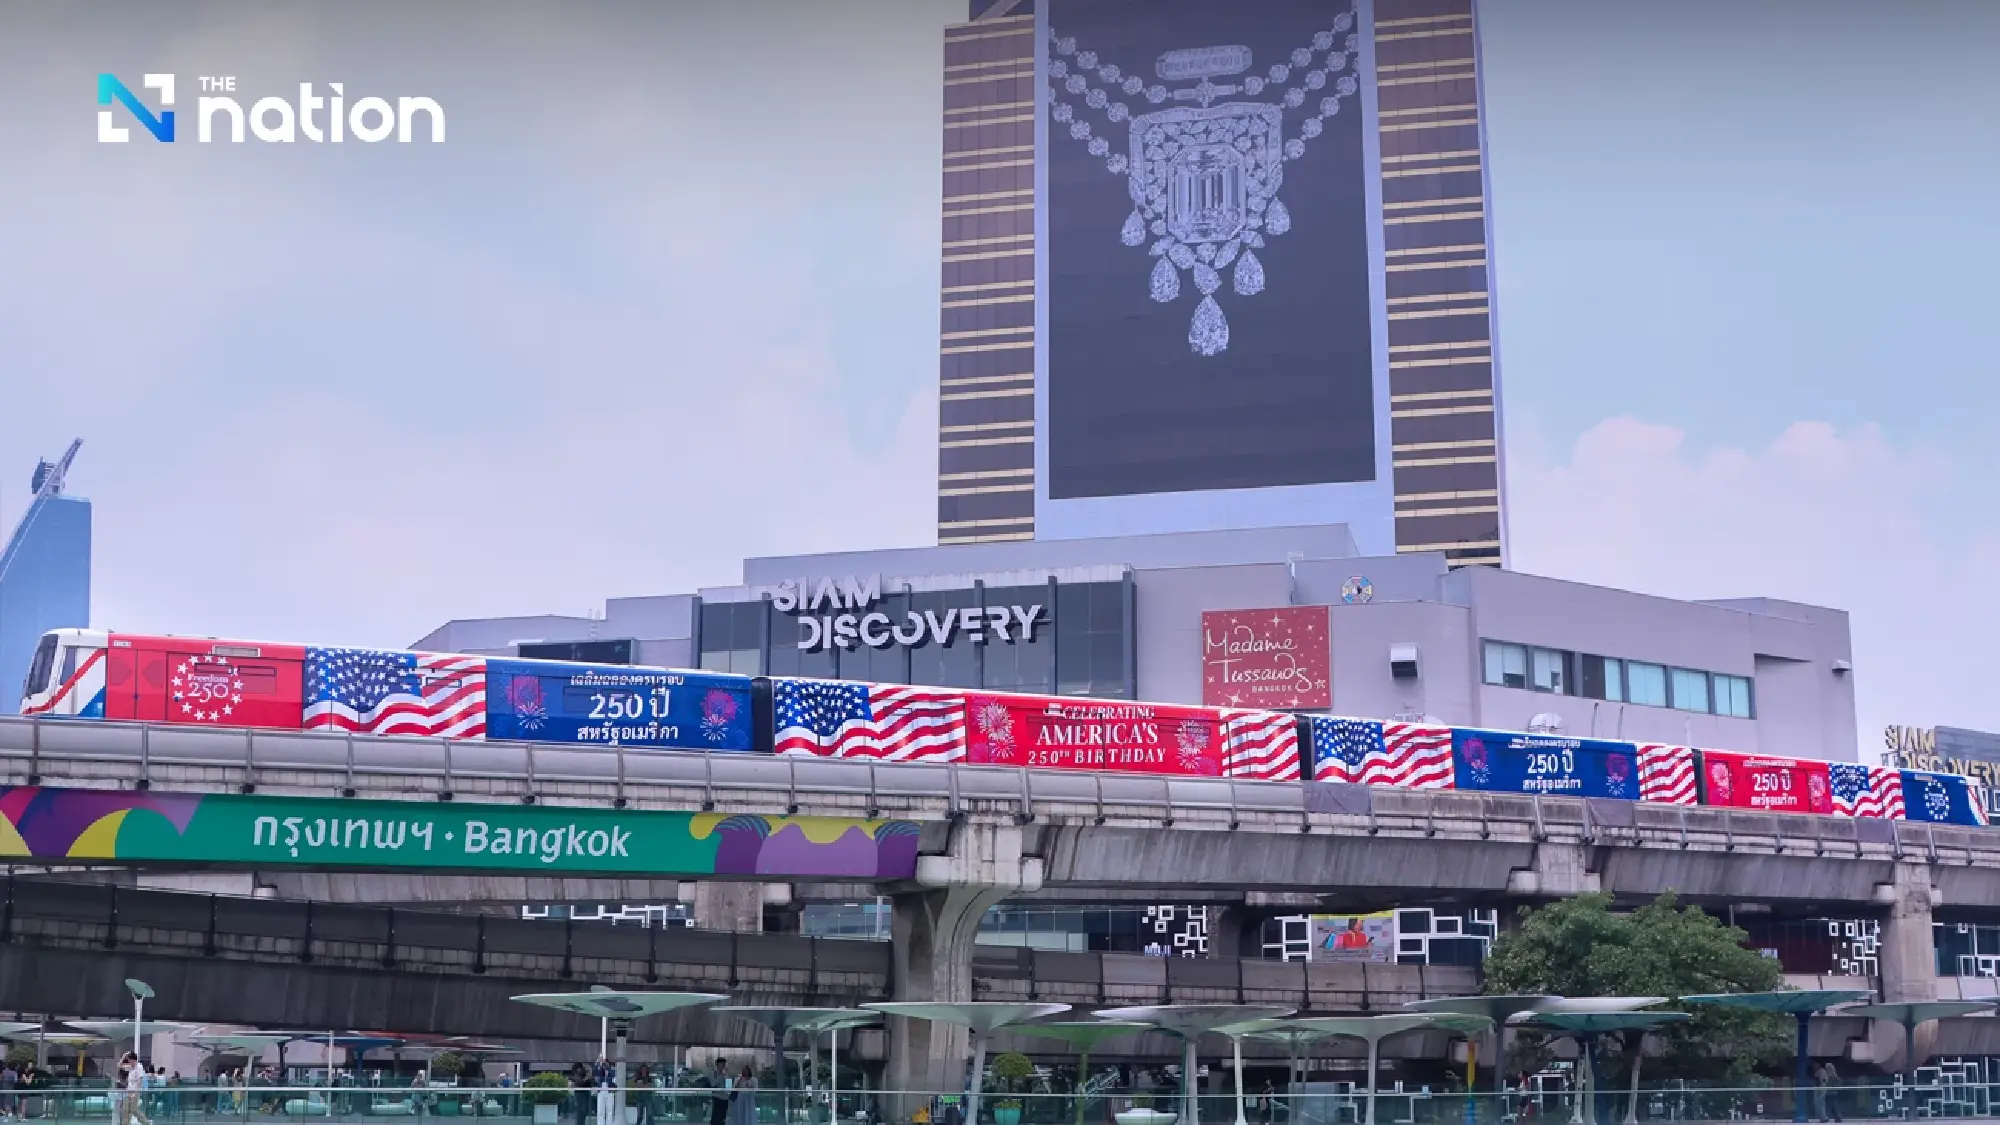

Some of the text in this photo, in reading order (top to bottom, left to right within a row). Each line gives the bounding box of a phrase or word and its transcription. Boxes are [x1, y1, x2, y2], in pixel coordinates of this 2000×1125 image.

[774, 574, 881, 612] SIAM
[797, 605, 1043, 650] DISCOVERY
[1206, 625, 1299, 657] Madame
[187, 673, 229, 683] Freedom
[1208, 652, 1313, 694] Tussauds
[187, 682, 229, 703] 250
[1251, 684, 1293, 692] BANGKOK
[588, 686, 671, 719] 250 ปี
[1063, 705, 1155, 720] CELEBRATING
[577, 721, 679, 746] สหรัฐอเมริกา
[1036, 722, 1158, 746] AMERICA'S
[1884, 724, 1935, 753] SIAM
[1074, 748, 1166, 763] BIRTHDAY
[1526, 748, 1574, 774] 250 ปี
[1752, 773, 1779, 791] 250
[253, 815, 632, 863] กรุงเทพฯ Bangkok
